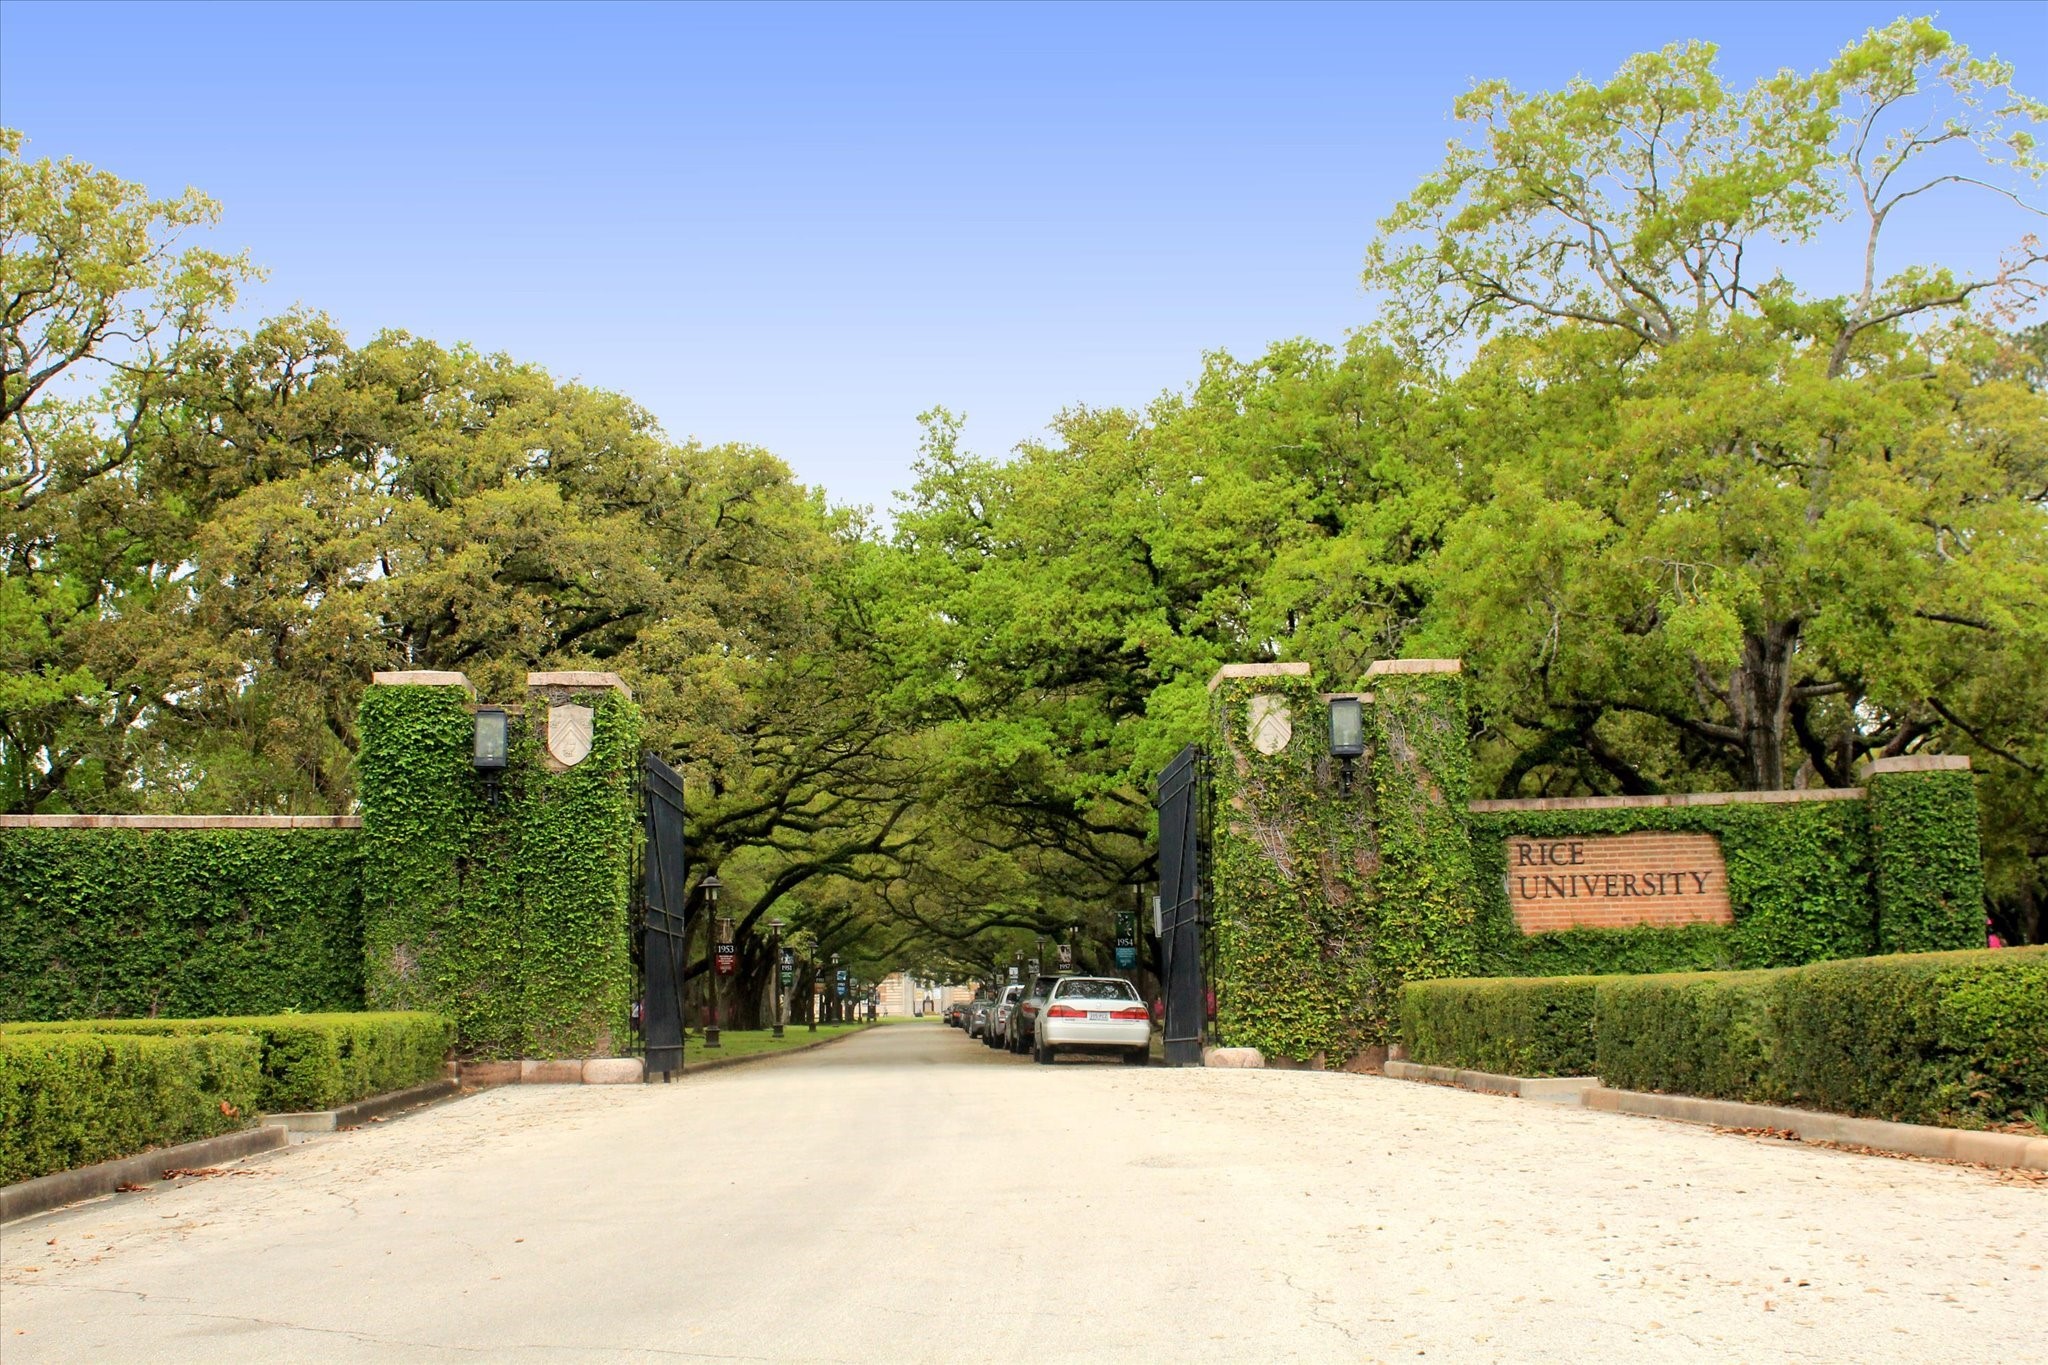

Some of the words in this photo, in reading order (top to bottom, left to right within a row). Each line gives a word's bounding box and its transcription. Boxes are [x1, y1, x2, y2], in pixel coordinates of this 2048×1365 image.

[1516, 841, 1585, 866] RICE
[1517, 871, 1711, 899] UNIVERSITY
[718, 945, 734, 953] 1953
[1117, 938, 1133, 946] 1954
